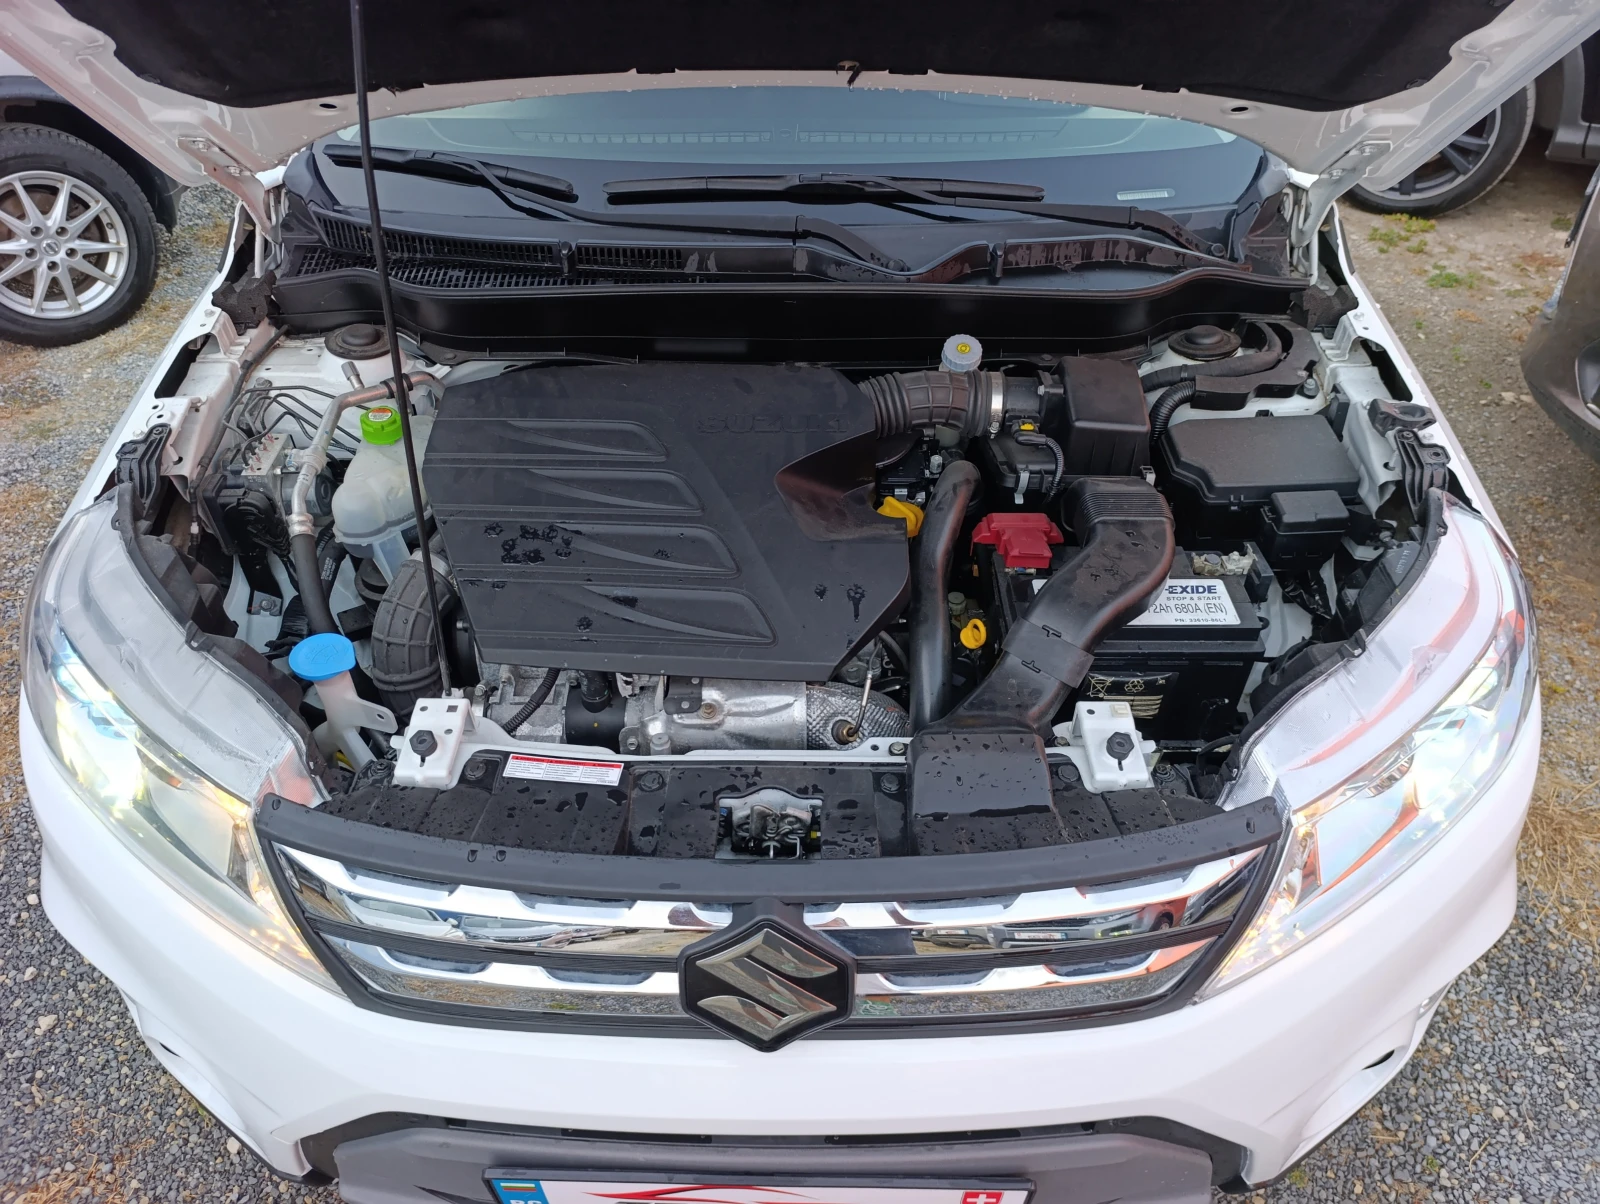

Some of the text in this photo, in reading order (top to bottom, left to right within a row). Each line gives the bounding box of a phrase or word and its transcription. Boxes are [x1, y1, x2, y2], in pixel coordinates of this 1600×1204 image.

[698, 413, 849, 434] SUZUKI
[1165, 585, 1218, 595] EXIDE
[1174, 602, 1203, 614] 680A
[1203, 602, 1228, 616] (EN)
